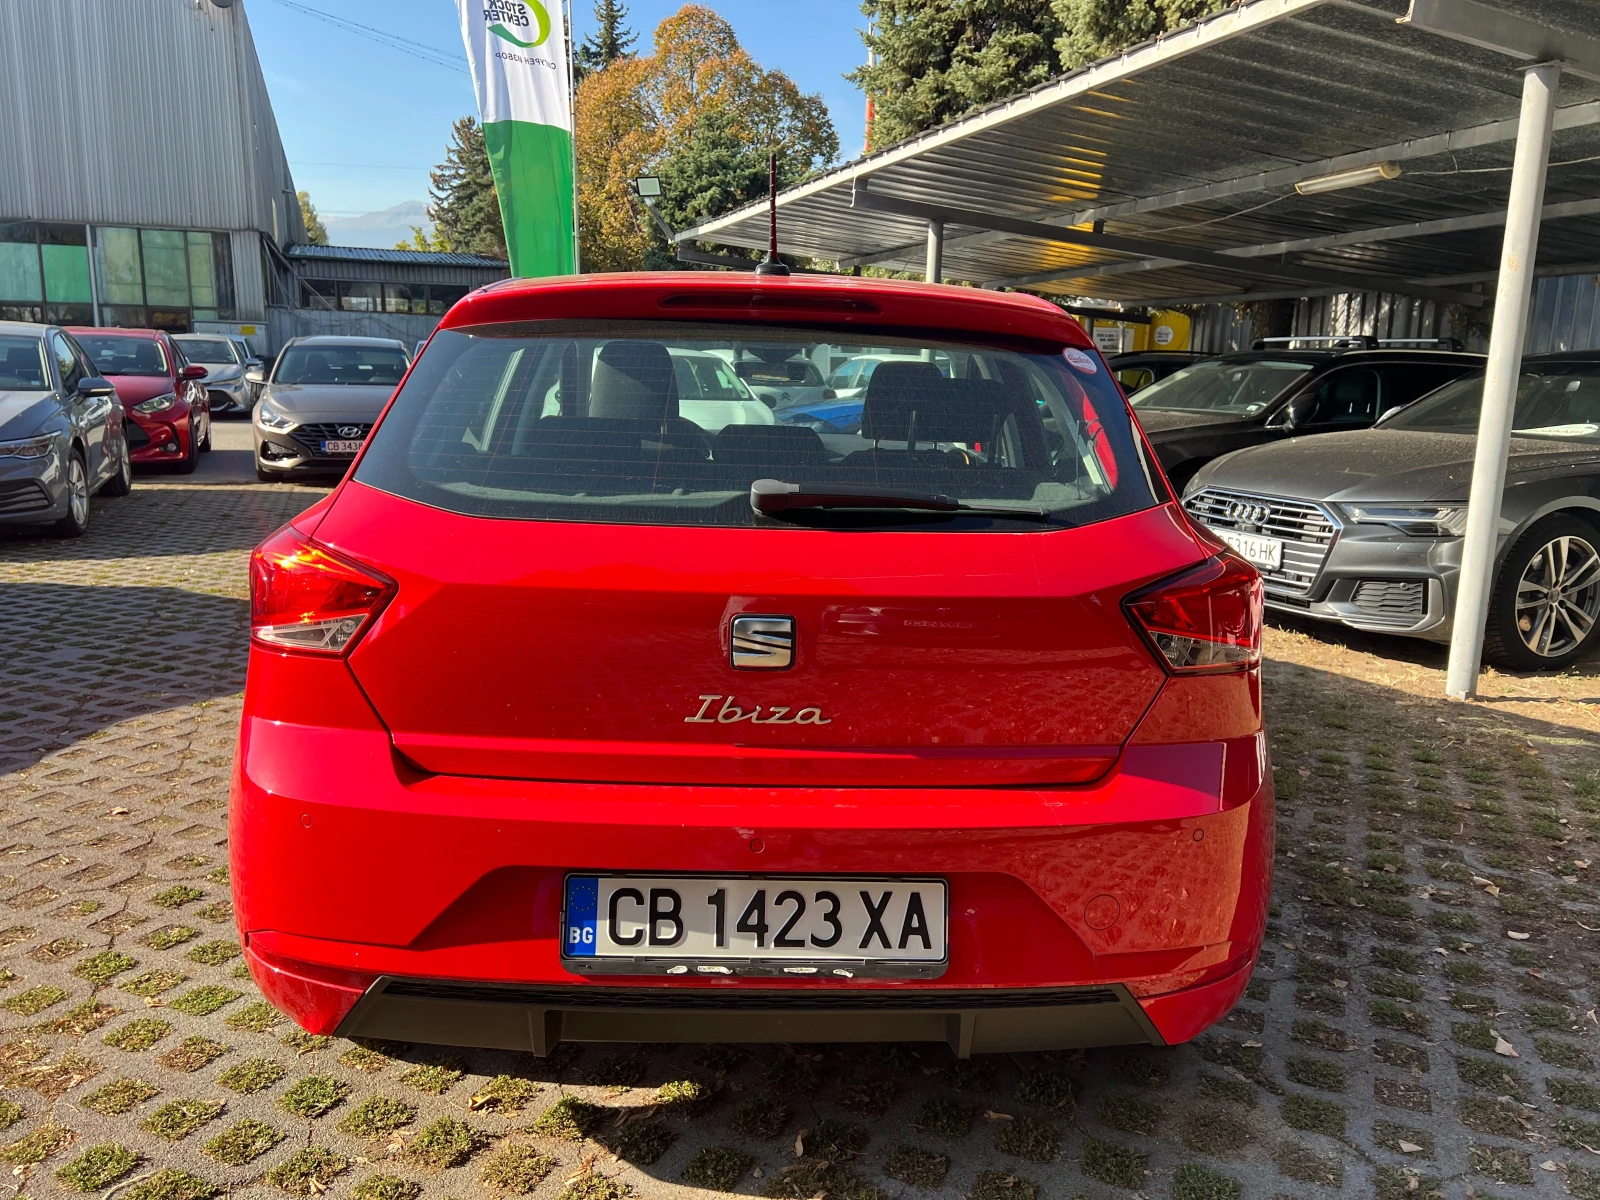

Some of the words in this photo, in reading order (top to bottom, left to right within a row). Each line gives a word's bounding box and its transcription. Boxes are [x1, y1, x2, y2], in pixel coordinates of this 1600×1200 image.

[1258, 542, 1277, 562] HK
[684, 694, 832, 725] Ibiza
[568, 926, 594, 944] BG
[607, 887, 684, 946] CB
[706, 888, 843, 949] 1423
[857, 890, 933, 950] XA
